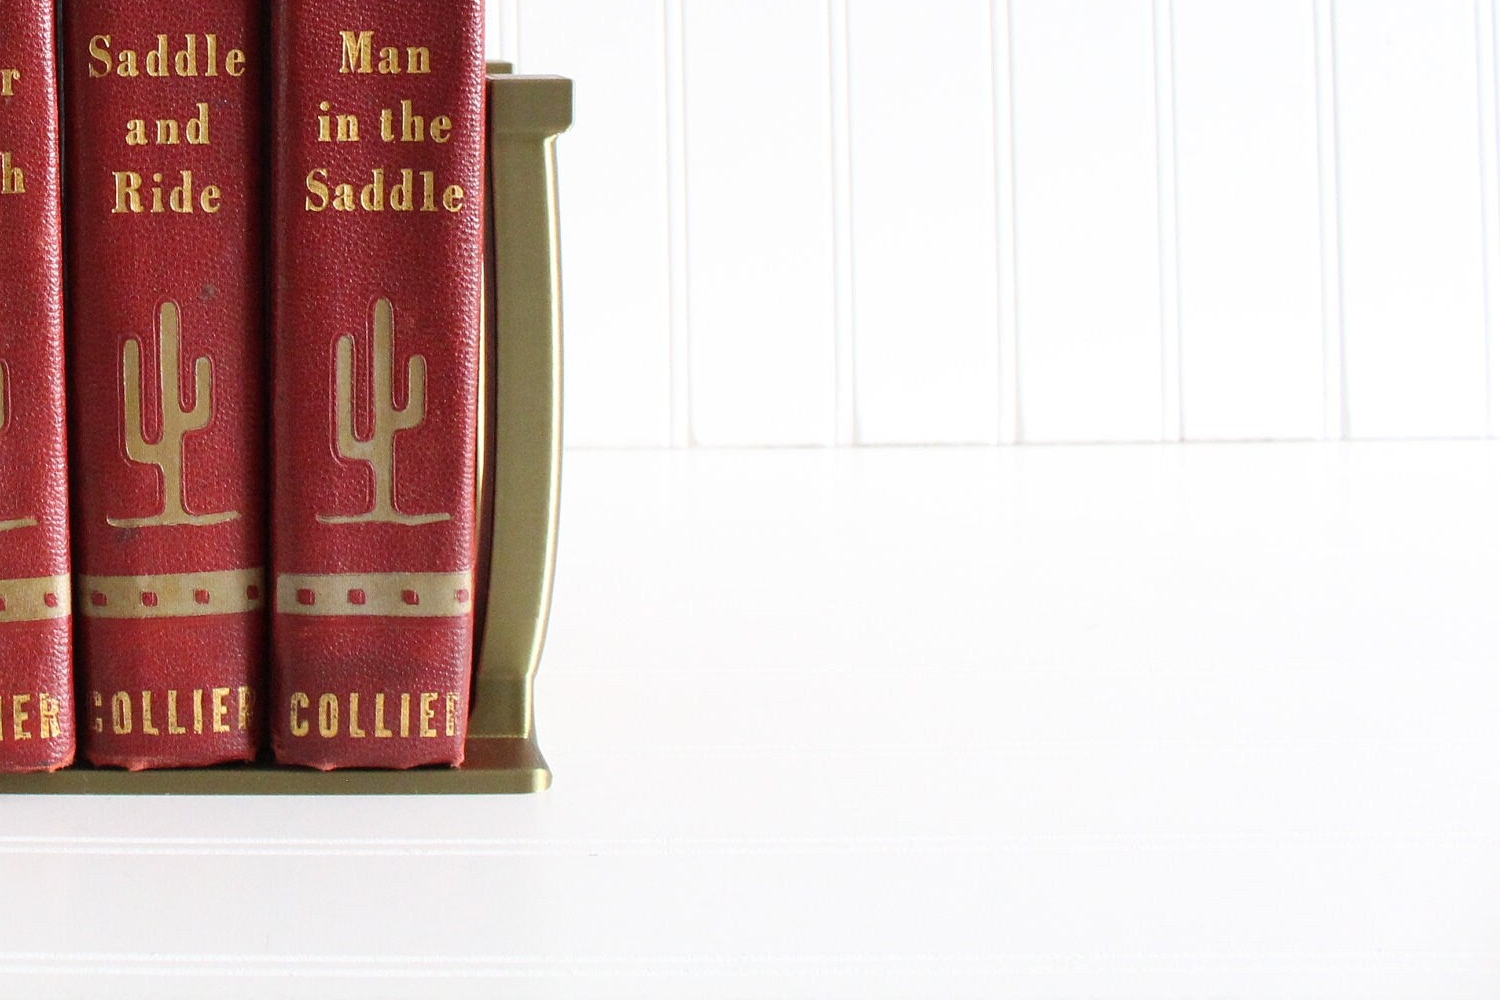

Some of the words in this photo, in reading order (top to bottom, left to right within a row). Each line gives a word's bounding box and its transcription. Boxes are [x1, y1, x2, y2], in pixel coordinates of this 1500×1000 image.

[88, 33, 247, 80] Saddle
[338, 29, 432, 75] Man
[125, 102, 211, 146] and
[316, 101, 359, 143] in
[380, 100, 453, 144] the
[111, 170, 222, 214] Ride
[304, 168, 465, 212] Saddle
